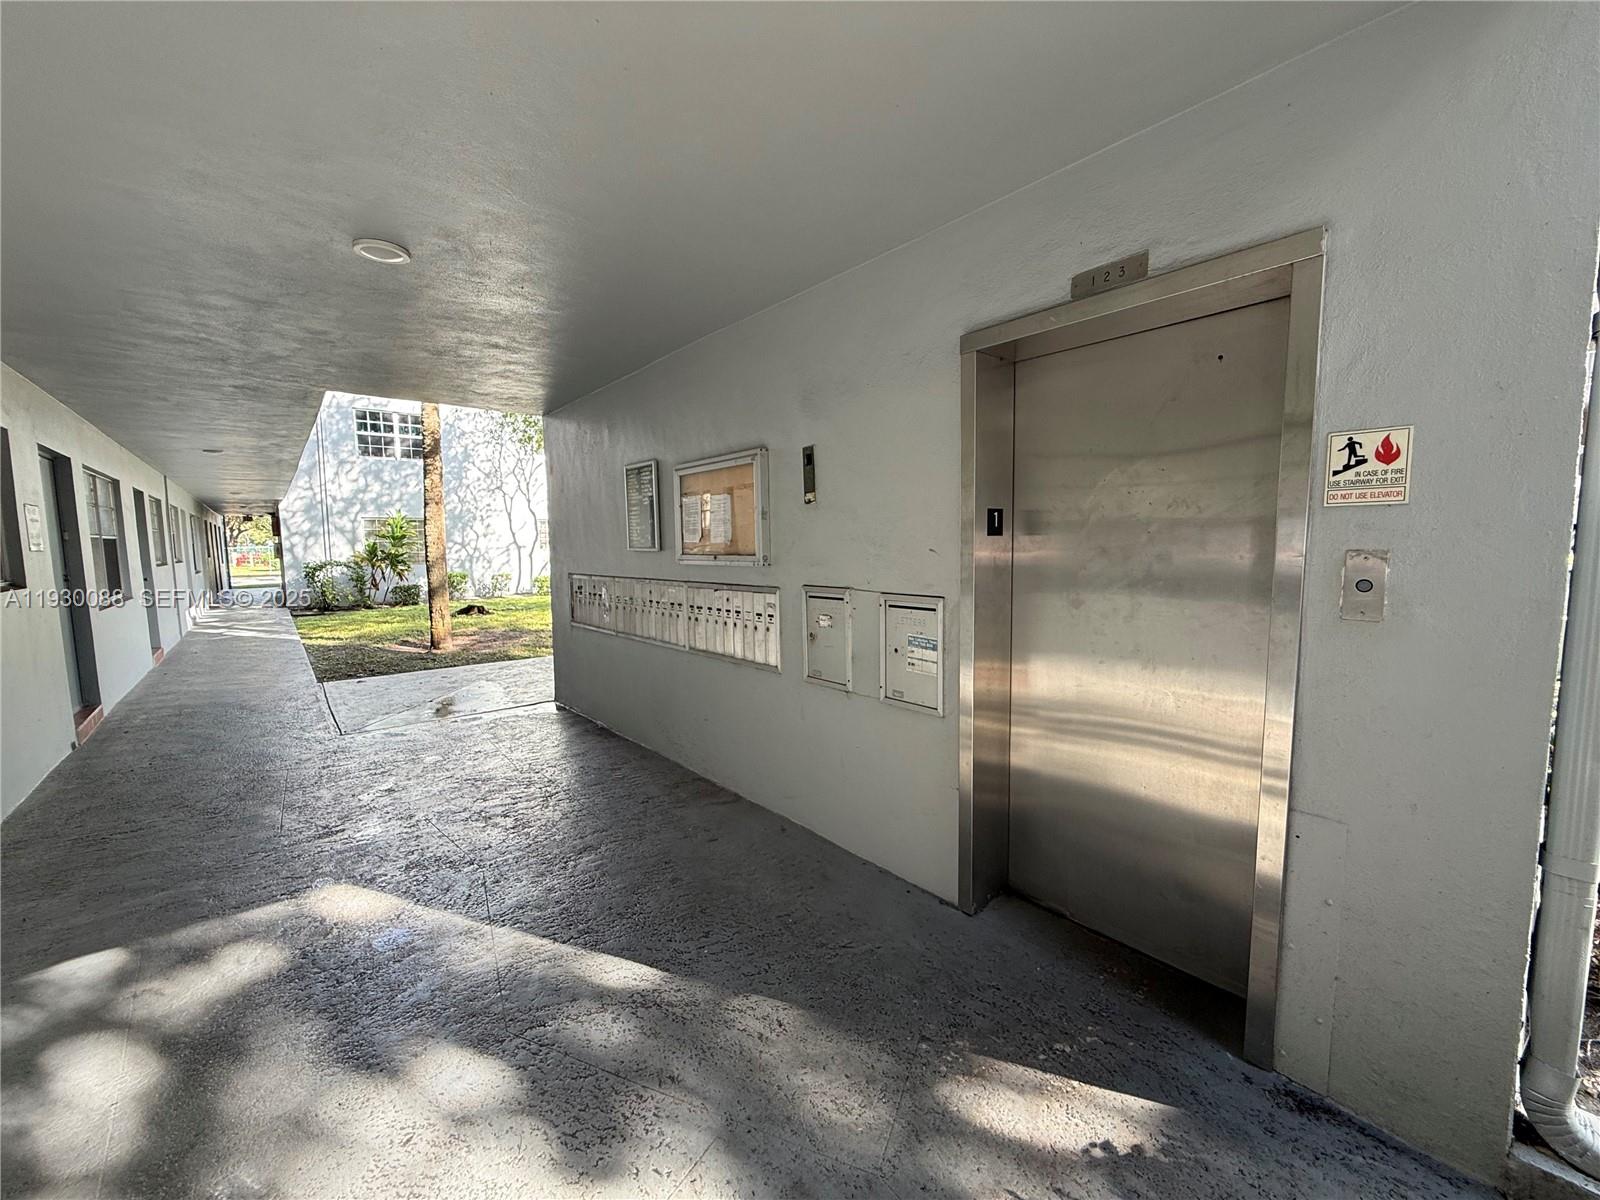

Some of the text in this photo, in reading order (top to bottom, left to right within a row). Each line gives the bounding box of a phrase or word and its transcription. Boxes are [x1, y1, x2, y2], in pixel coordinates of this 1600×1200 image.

[1362, 469, 1379, 477] CASE
[1380, 468, 1389, 476] OF
[1390, 467, 1405, 475] FIRE
[1329, 479, 1341, 487] USE
[1342, 478, 1375, 486] STAIRWAY
[1391, 476, 1405, 484] EXIT
[1340, 492, 1354, 500] NOT
[1355, 491, 1368, 499] USE
[1369, 490, 1403, 499] ELEVATOR
[993, 511, 999, 528] 1
